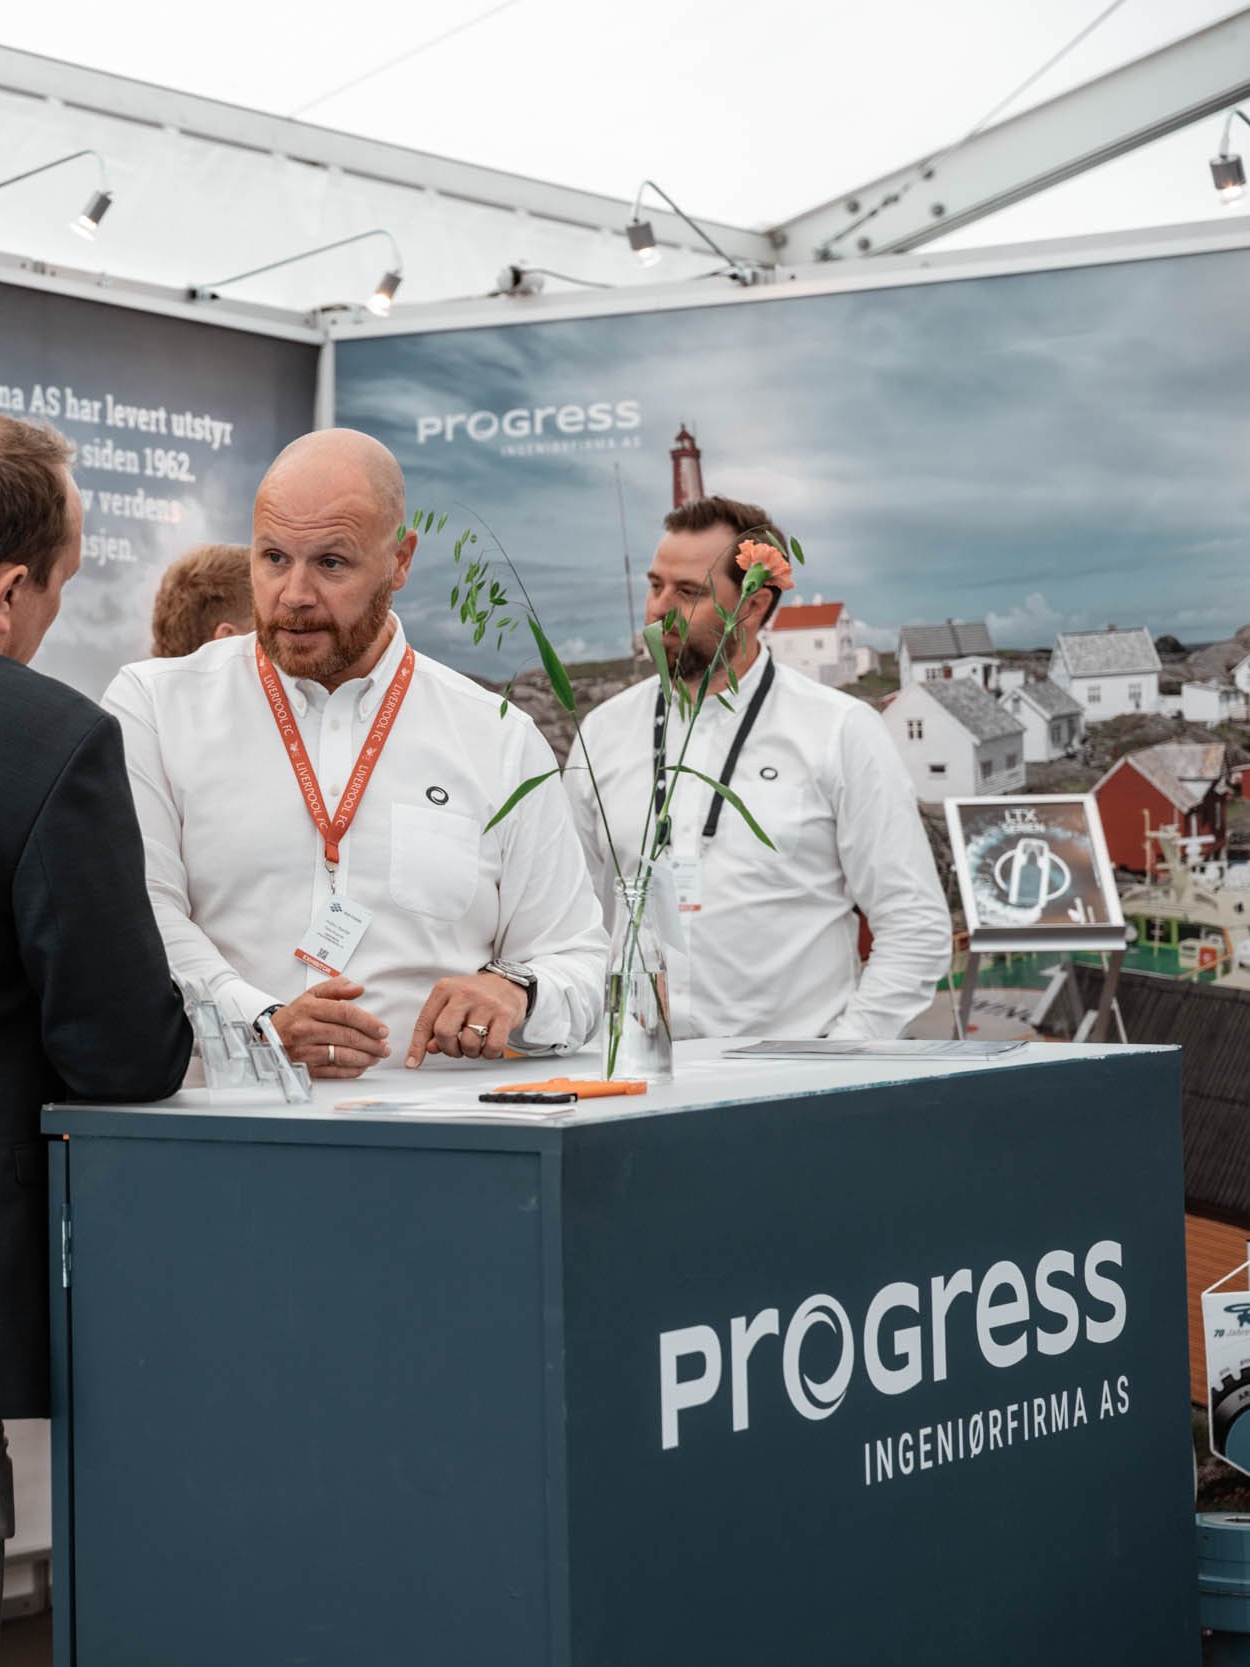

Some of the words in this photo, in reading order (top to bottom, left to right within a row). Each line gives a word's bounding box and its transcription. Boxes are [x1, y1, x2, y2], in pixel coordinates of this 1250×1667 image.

[29, 384, 60, 418] AS
[65, 387, 102, 424] har
[105, 394, 167, 435] levert
[171, 411, 233, 450] utstyr
[82, 438, 139, 475] siden
[144, 447, 196, 482] 1962.
[97, 487, 183, 523] verdens
[263, 675, 288, 725] LIVERPOOL
[283, 725, 294, 736] FC
[377, 684, 402, 731] LIVERPOOL
[371, 730, 384, 742] FC
[296, 762, 321, 816] LIVERPOOL
[316, 818, 328, 830] FC
[342, 764, 369, 814] LIVERPOOL
[335, 814, 349, 829] FC
[865, 1387, 1088, 1486] INGENIØRFIRMA
[1100, 1375, 1130, 1420] AS
